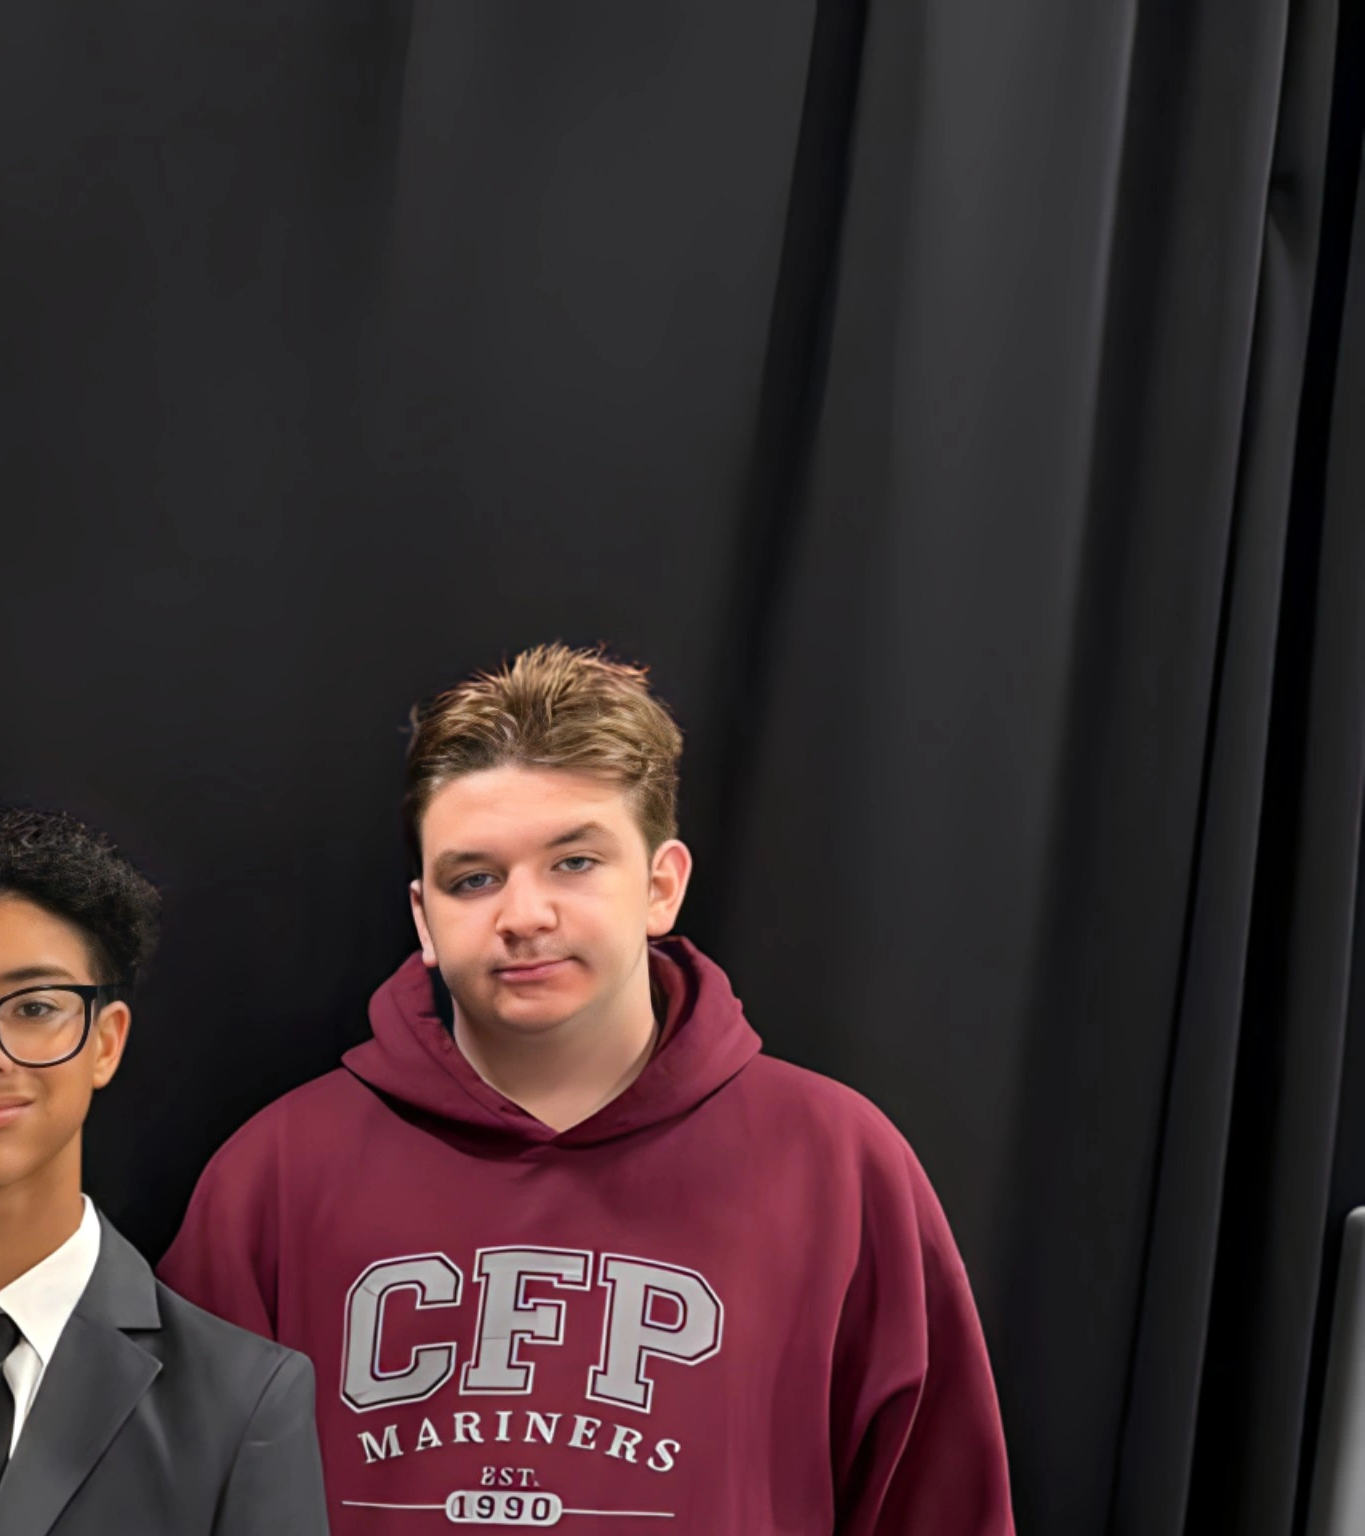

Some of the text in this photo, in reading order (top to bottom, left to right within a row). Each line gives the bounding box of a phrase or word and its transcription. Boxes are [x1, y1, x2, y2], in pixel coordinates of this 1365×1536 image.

[341, 1245, 724, 1414] CFP
[357, 1410, 681, 1473] MARINERS
[480, 1465, 540, 1488] EST.
[450, 1494, 553, 1521] 1990
